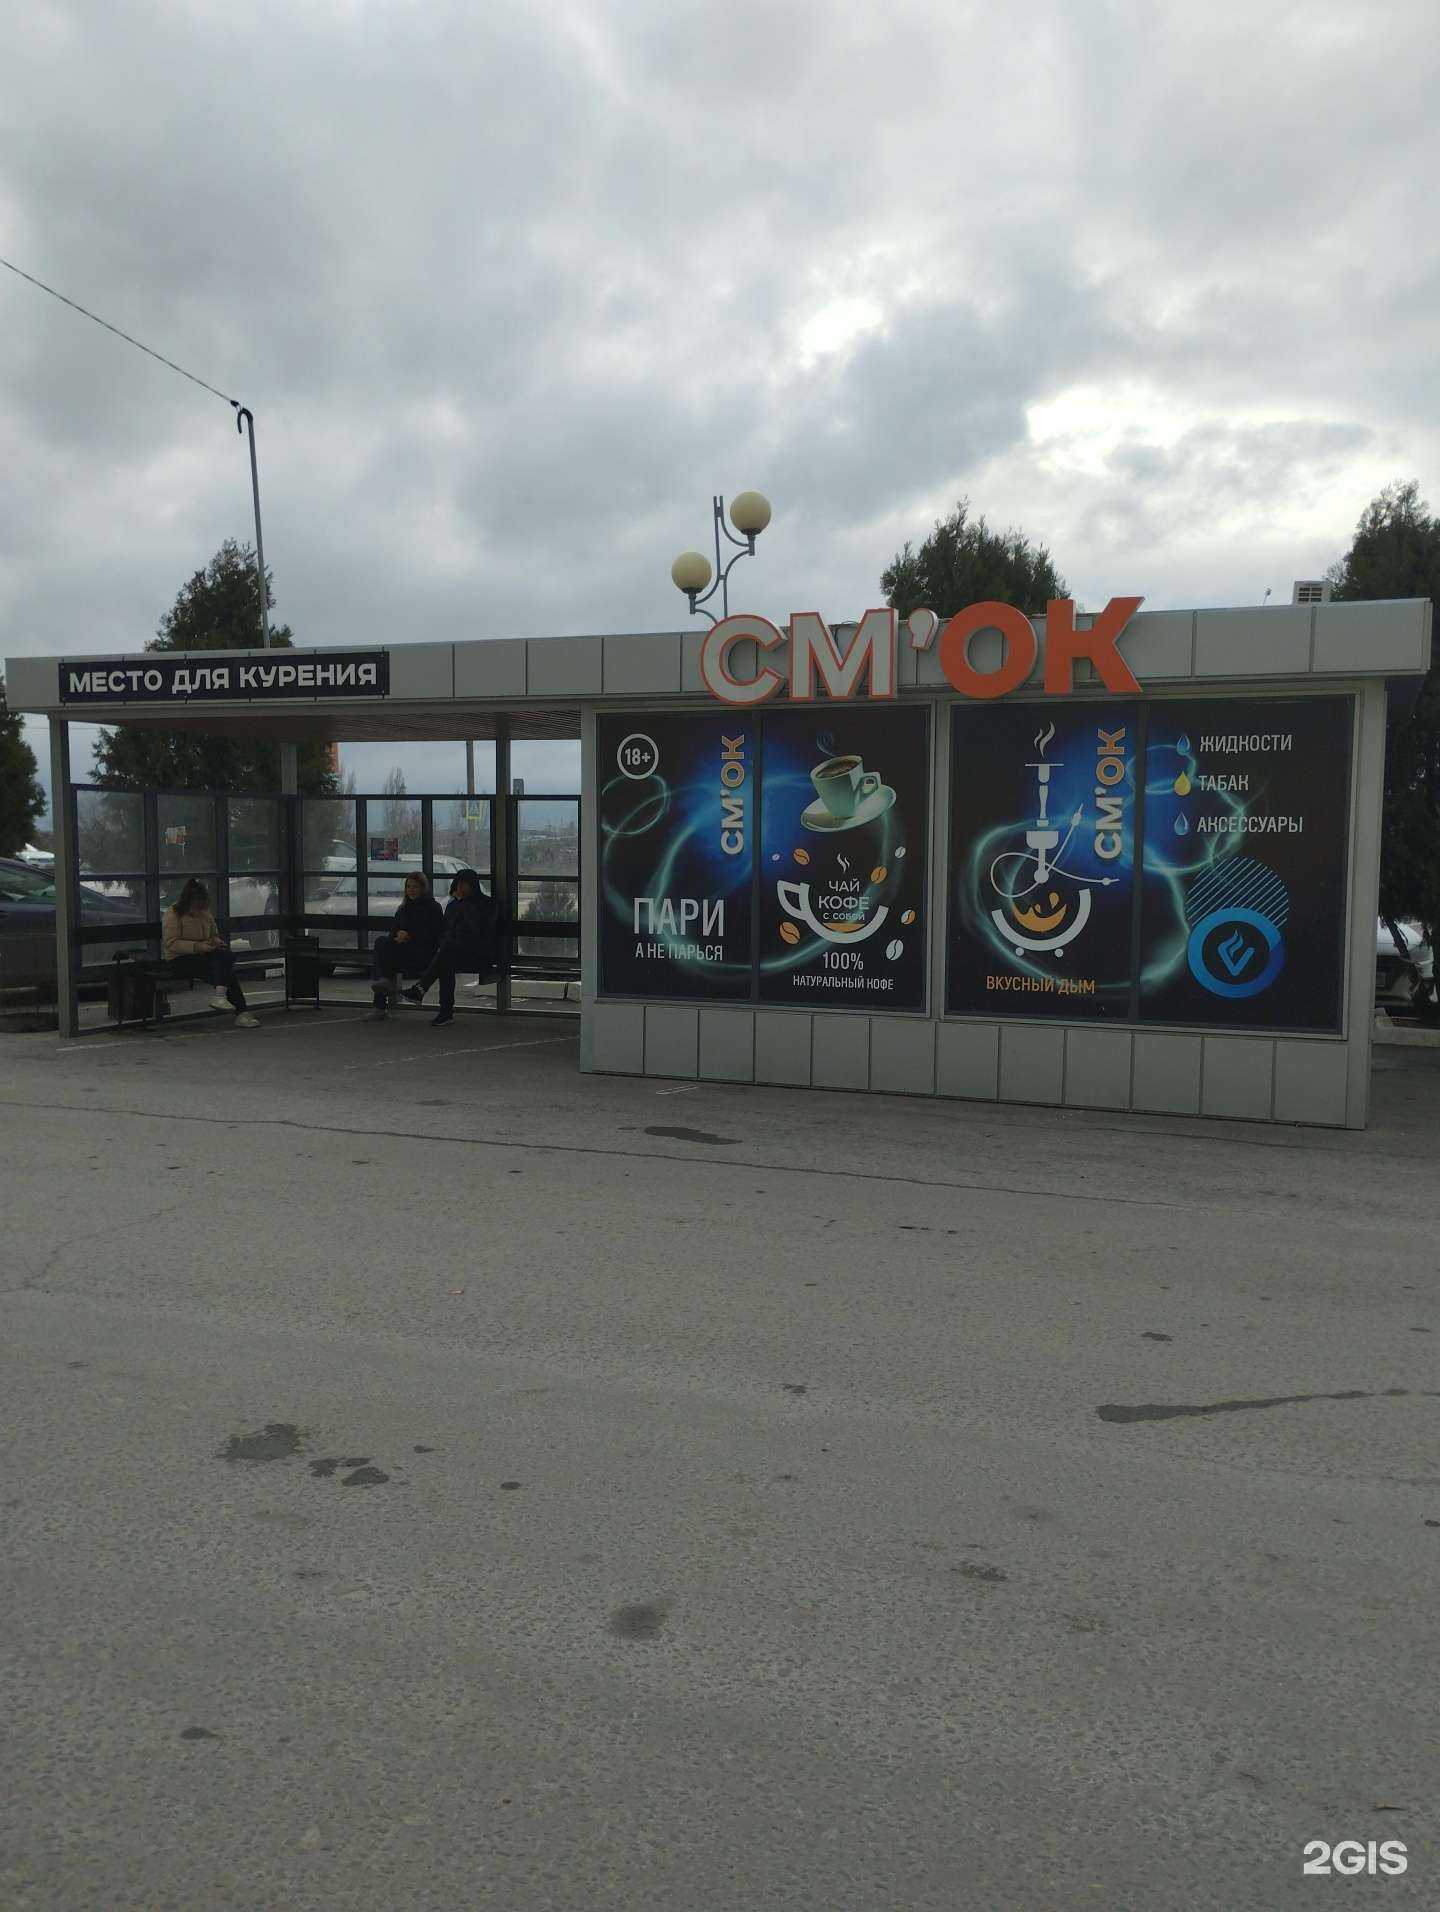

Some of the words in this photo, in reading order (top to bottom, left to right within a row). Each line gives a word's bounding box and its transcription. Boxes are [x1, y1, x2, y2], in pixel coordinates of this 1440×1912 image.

[69, 669, 163, 693] МЕСТО
[171, 667, 229, 694] ДЛЯ
[239, 663, 377, 688] КУРЕНИЯ
[1200, 734, 1292, 753] ЖИДКОСТИ
[624, 746, 651, 766] 18+
[1198, 774, 1249, 792] ТАБАК
[1197, 815, 1303, 834] АКСЕССУАРЫ
[828, 878, 860, 893] ЧАЙ
[818, 895, 870, 910] КОФЕ
[634, 897, 724, 936] ПАРИ
[823, 912, 830, 920] С
[832, 910, 866, 920] СОБОЙ
[635, 942, 644, 958] А
[647, 943, 665, 958] НЕ
[668, 943, 723, 960] ПАРЬСЯ
[822, 951, 864, 970] 100%
[793, 975, 864, 989] НАТУРАЛЬНЫЙ
[867, 979, 894, 990] КОФЕ
[986, 975, 1054, 993] ВКУСНЫЙ
[1058, 977, 1095, 995] ДЫМ
